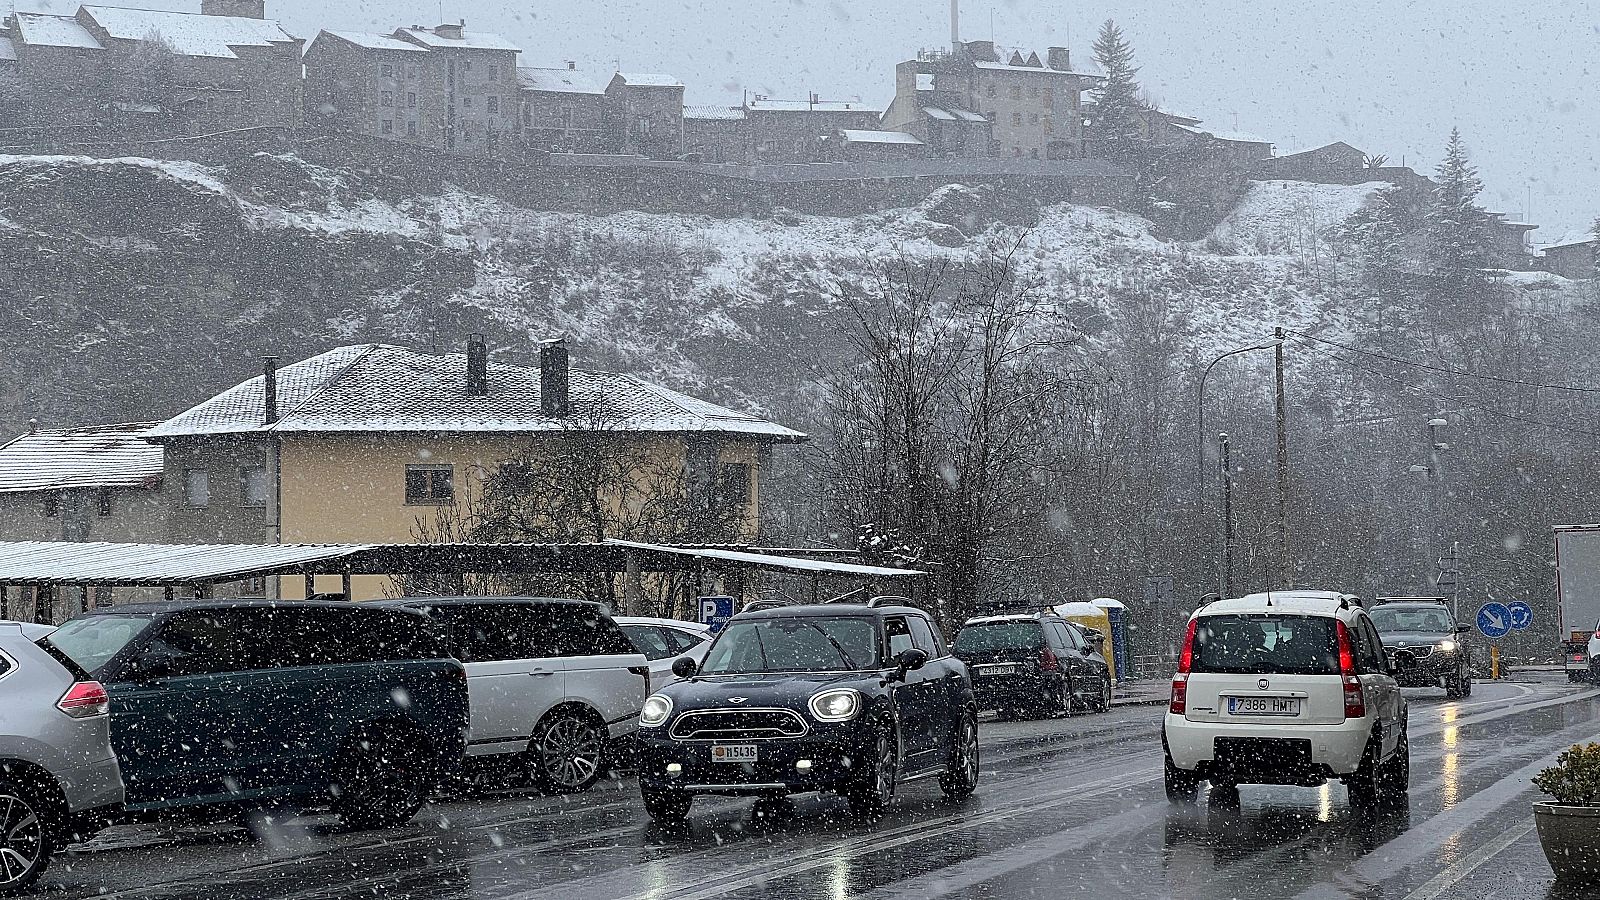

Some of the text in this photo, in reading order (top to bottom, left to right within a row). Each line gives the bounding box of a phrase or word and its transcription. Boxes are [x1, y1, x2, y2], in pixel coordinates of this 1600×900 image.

[703, 601, 717, 622] P
[1237, 699, 1267, 711] 7386
[1272, 700, 1295, 712] HMT
